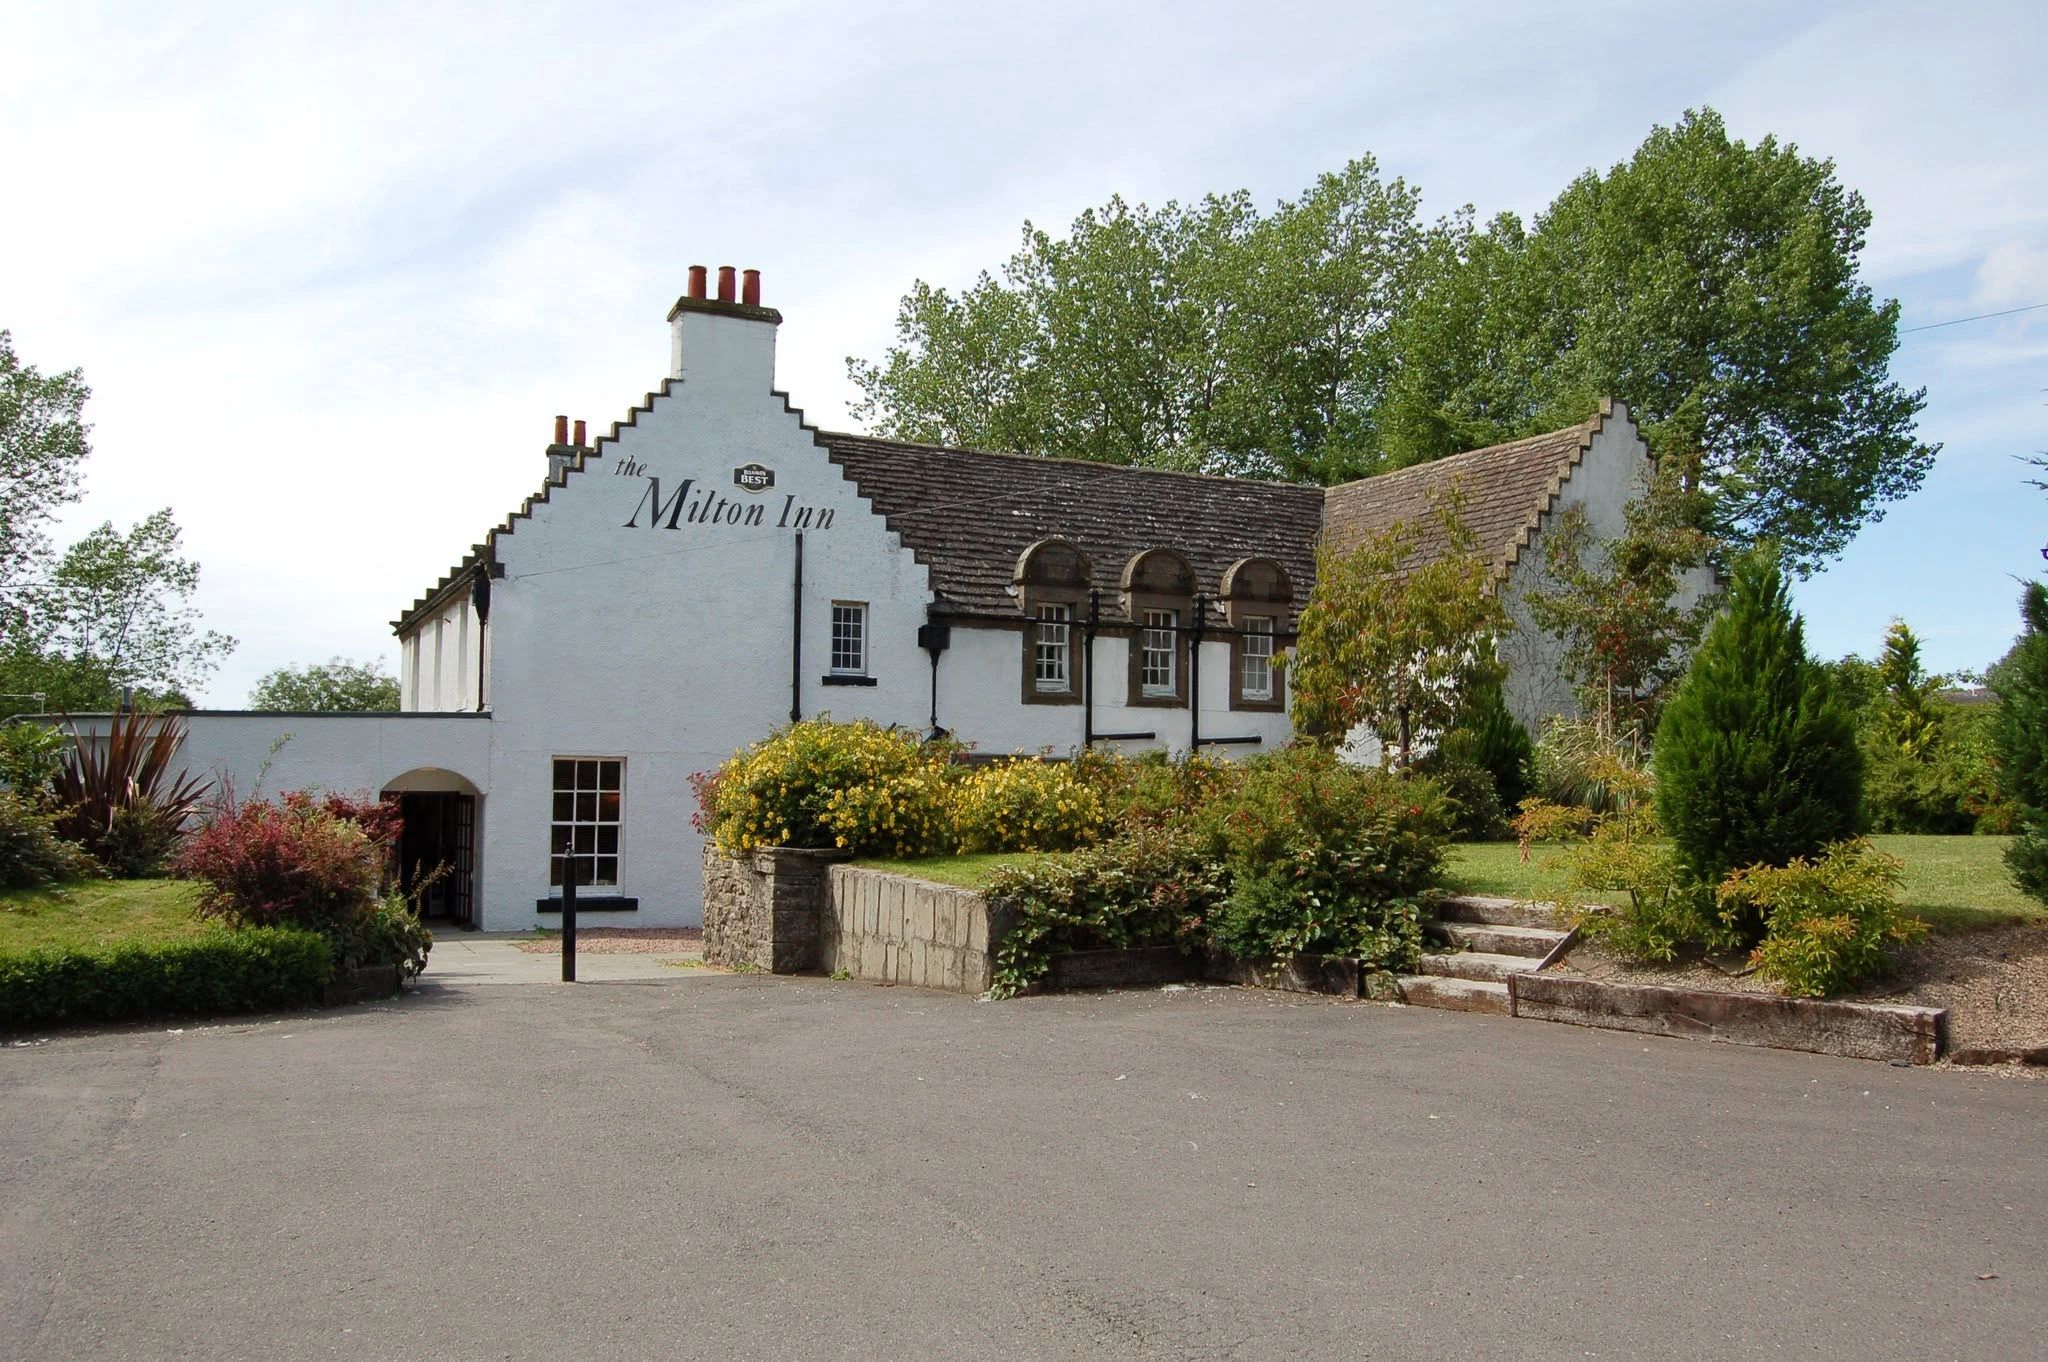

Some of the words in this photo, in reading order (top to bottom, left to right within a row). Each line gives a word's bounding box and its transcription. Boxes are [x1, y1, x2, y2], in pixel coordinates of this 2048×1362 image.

[614, 455, 647, 477] the
[741, 474, 769, 485] BEST
[622, 476, 766, 530] Milton
[776, 494, 836, 530] Inn
